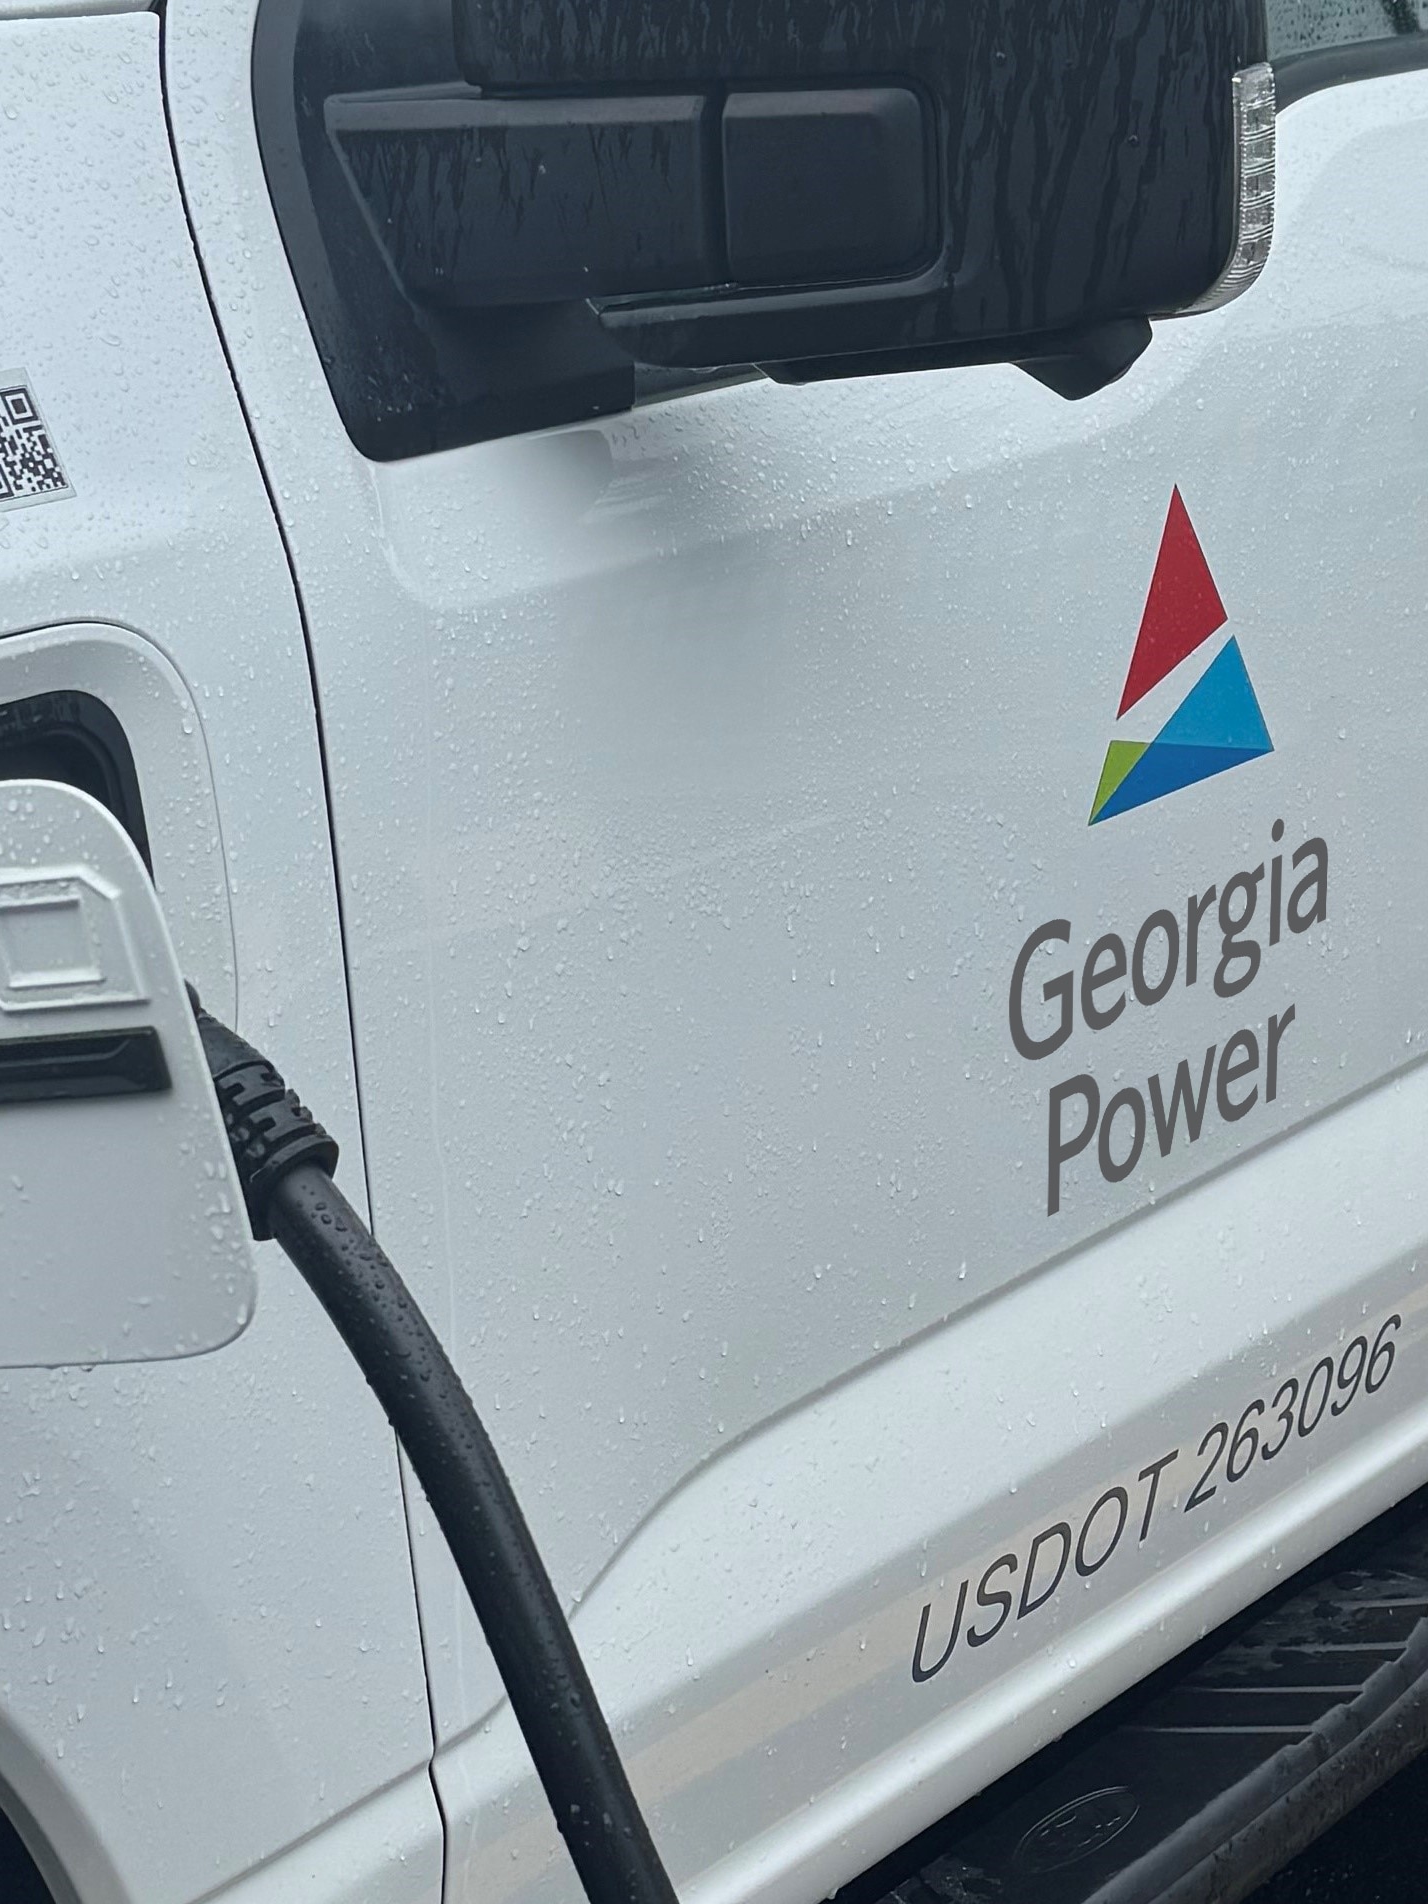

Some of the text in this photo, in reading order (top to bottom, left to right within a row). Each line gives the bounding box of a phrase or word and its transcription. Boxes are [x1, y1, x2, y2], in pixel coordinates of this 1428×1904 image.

[1009, 818, 1328, 1060] Georgia
[1048, 1004, 1295, 1216] Power
[912, 1314, 1401, 1682] USDOT 263096
